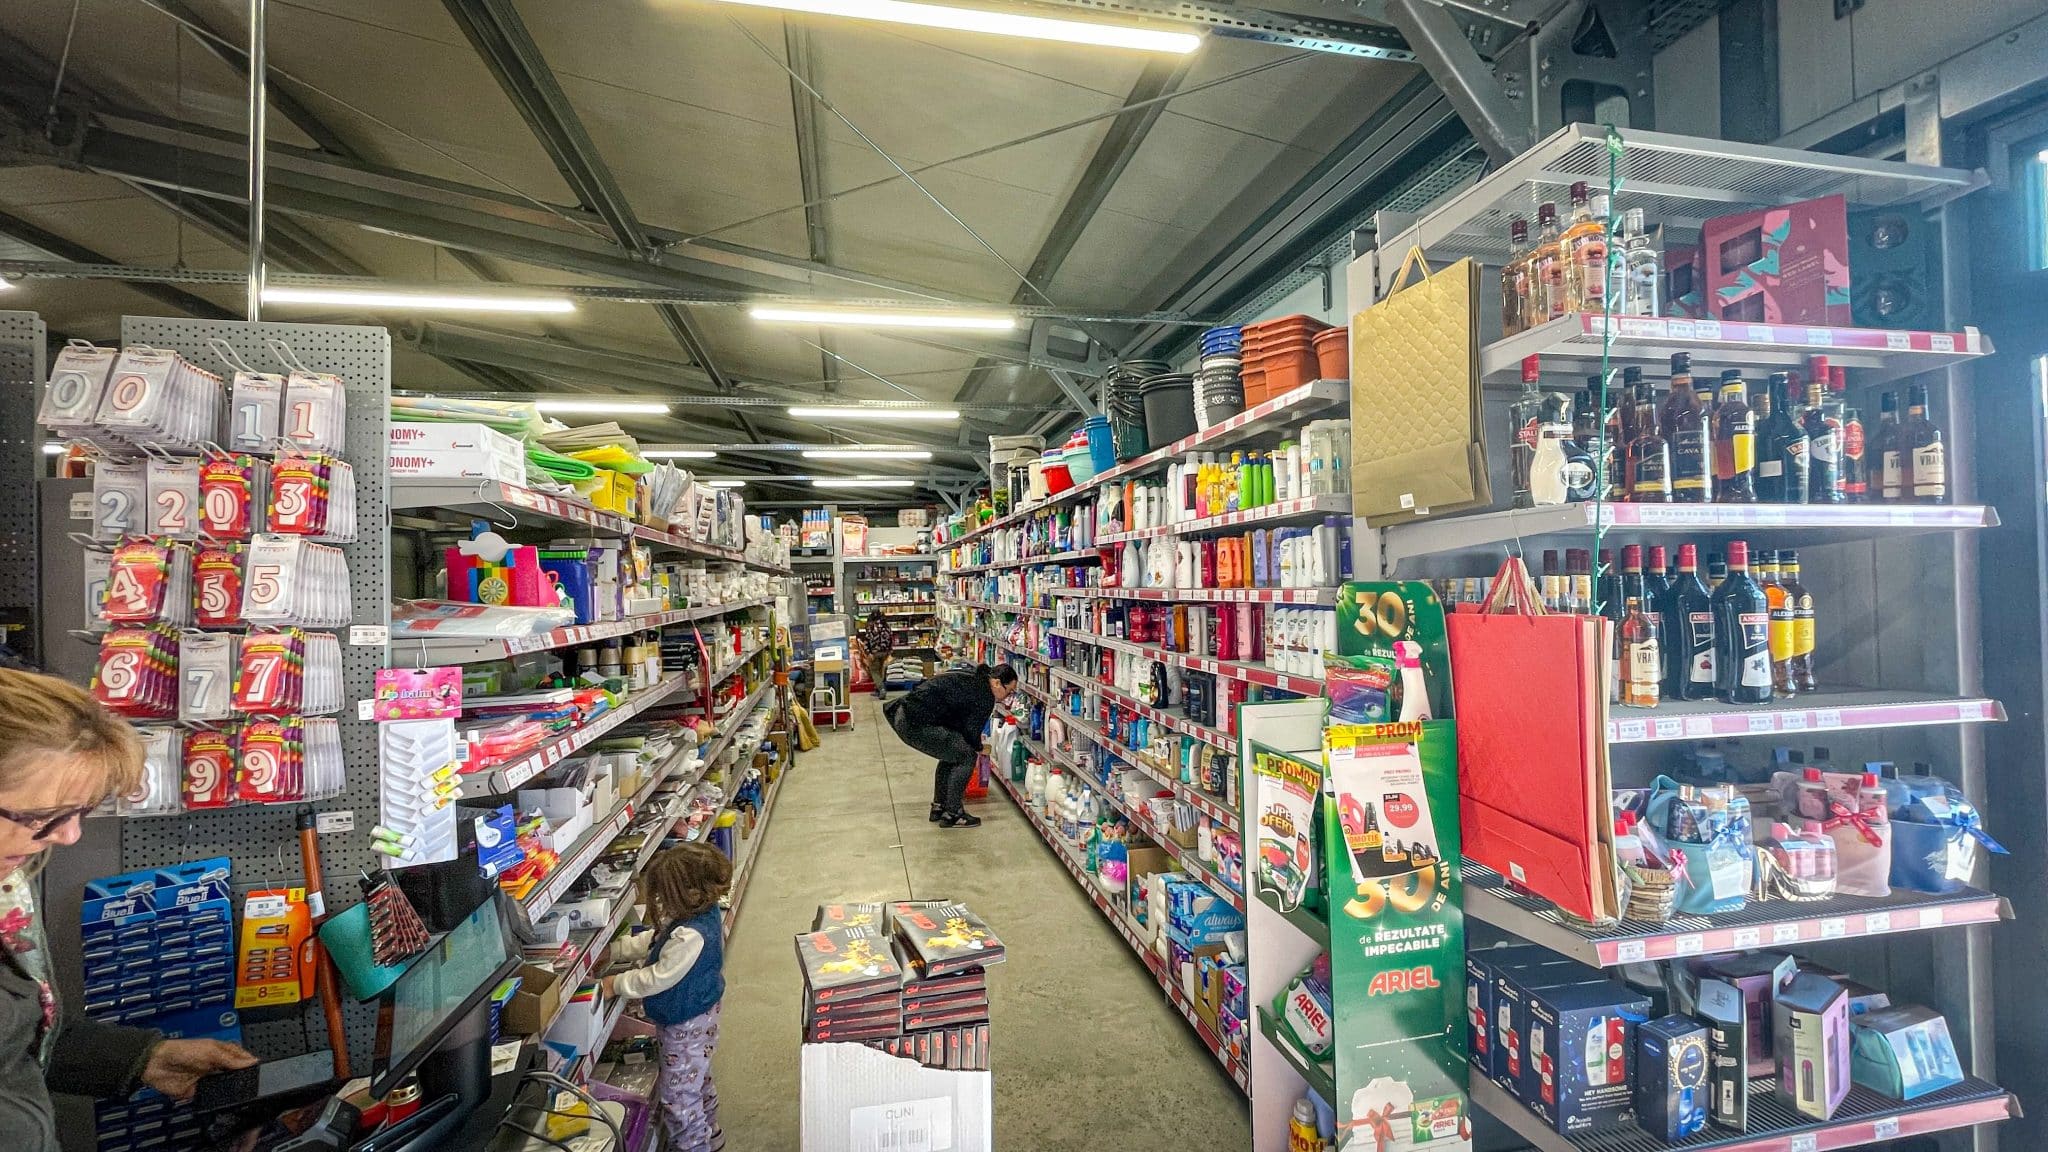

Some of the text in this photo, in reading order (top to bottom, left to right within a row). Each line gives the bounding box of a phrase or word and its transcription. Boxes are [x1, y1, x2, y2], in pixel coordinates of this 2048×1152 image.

[101, 490, 130, 527] 2
[157, 490, 186, 527] 2
[206, 487, 239, 524] 0
[275, 483, 308, 516] 3
[111, 567, 145, 603] 4
[202, 575, 230, 612] 5
[250, 564, 280, 604] 5
[1354, 591, 1405, 637] 30
[102, 651, 138, 690] 6
[187, 670, 214, 707] 7
[247, 656, 279, 698] 7
[1375, 721, 1421, 738] PROM
[189, 758, 221, 795] 9
[244, 750, 277, 788] 9
[1431, 861, 1450, 912] DE ANI
[1205, 913, 1241, 928] always
[1359, 924, 1445, 945] de REZULTATE
[1365, 938, 1440, 957] IMPECABILE
[258, 986, 268, 998] 8
[1368, 965, 1441, 996] ARIEL
[1294, 993, 1328, 1038] ARIEL
[1433, 1119, 1457, 1129] ARIEL
